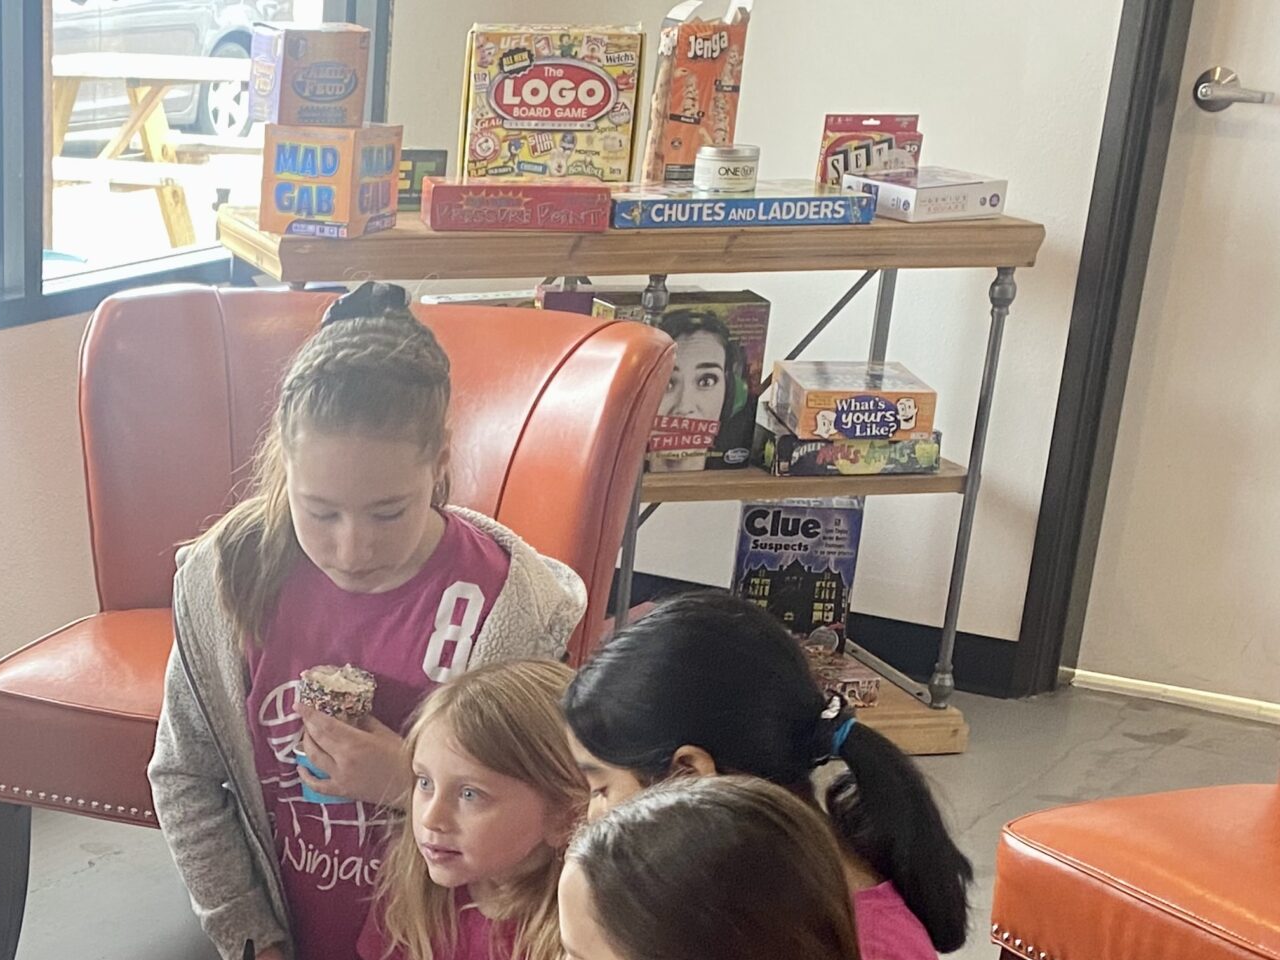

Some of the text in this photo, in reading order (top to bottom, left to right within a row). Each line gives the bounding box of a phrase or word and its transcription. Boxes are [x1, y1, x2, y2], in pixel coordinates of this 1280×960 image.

[687, 30, 729, 58] Jenga
[544, 66, 564, 77] The
[502, 78, 605, 107] LOGO
[512, 106, 588, 118] BOARD GAME
[275, 142, 340, 178] MAD
[275, 182, 336, 217] GAB
[651, 200, 845, 222] CHUTES AND LADDERS
[836, 398, 886, 411] What's
[841, 411, 897, 428] yours
[855, 422, 898, 438] Like?
[745, 508, 822, 539] Clue
[751, 539, 809, 552] Suspects
[422, 580, 485, 683] 8
